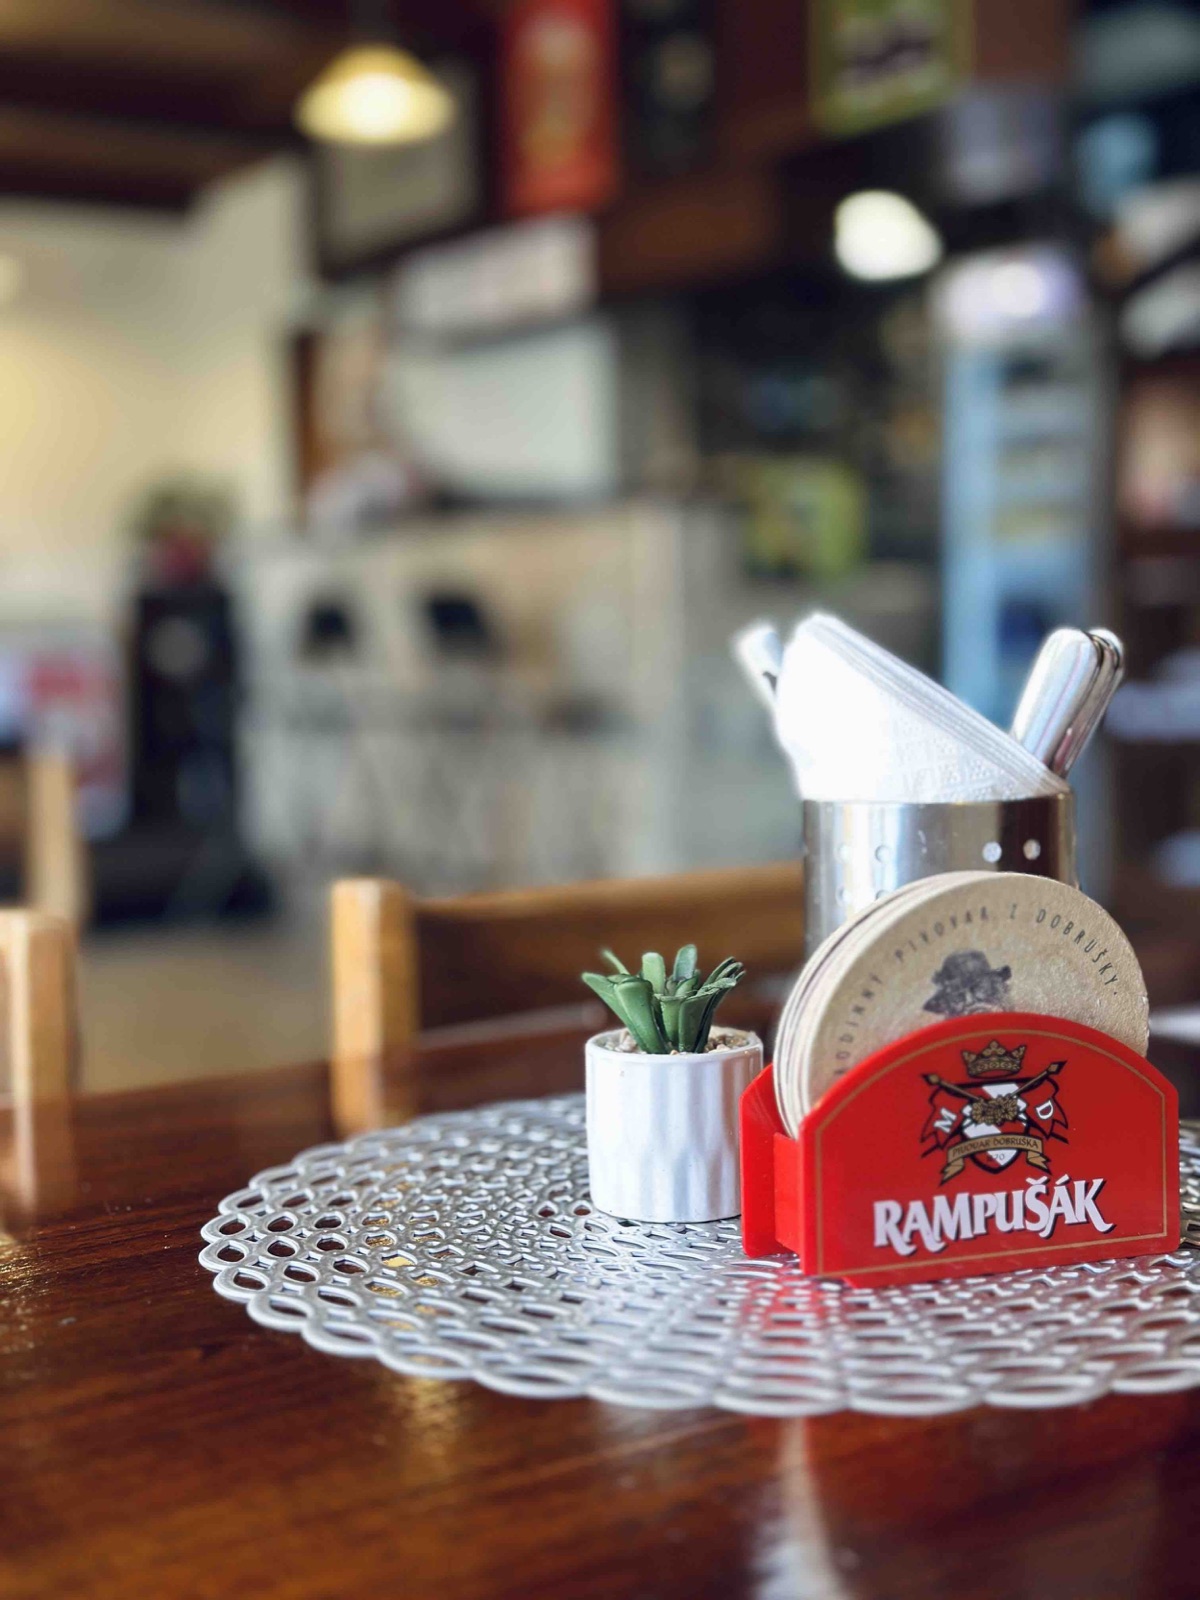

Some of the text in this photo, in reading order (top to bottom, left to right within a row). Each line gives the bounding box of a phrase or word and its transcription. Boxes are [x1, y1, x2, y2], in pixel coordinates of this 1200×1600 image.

[1036, 908, 1118, 995] DOBRUŠKY.
[934, 1108, 957, 1133] M
[1036, 1100, 1054, 1120] D
[873, 1174, 1114, 1256] RAMPUŠÁK
